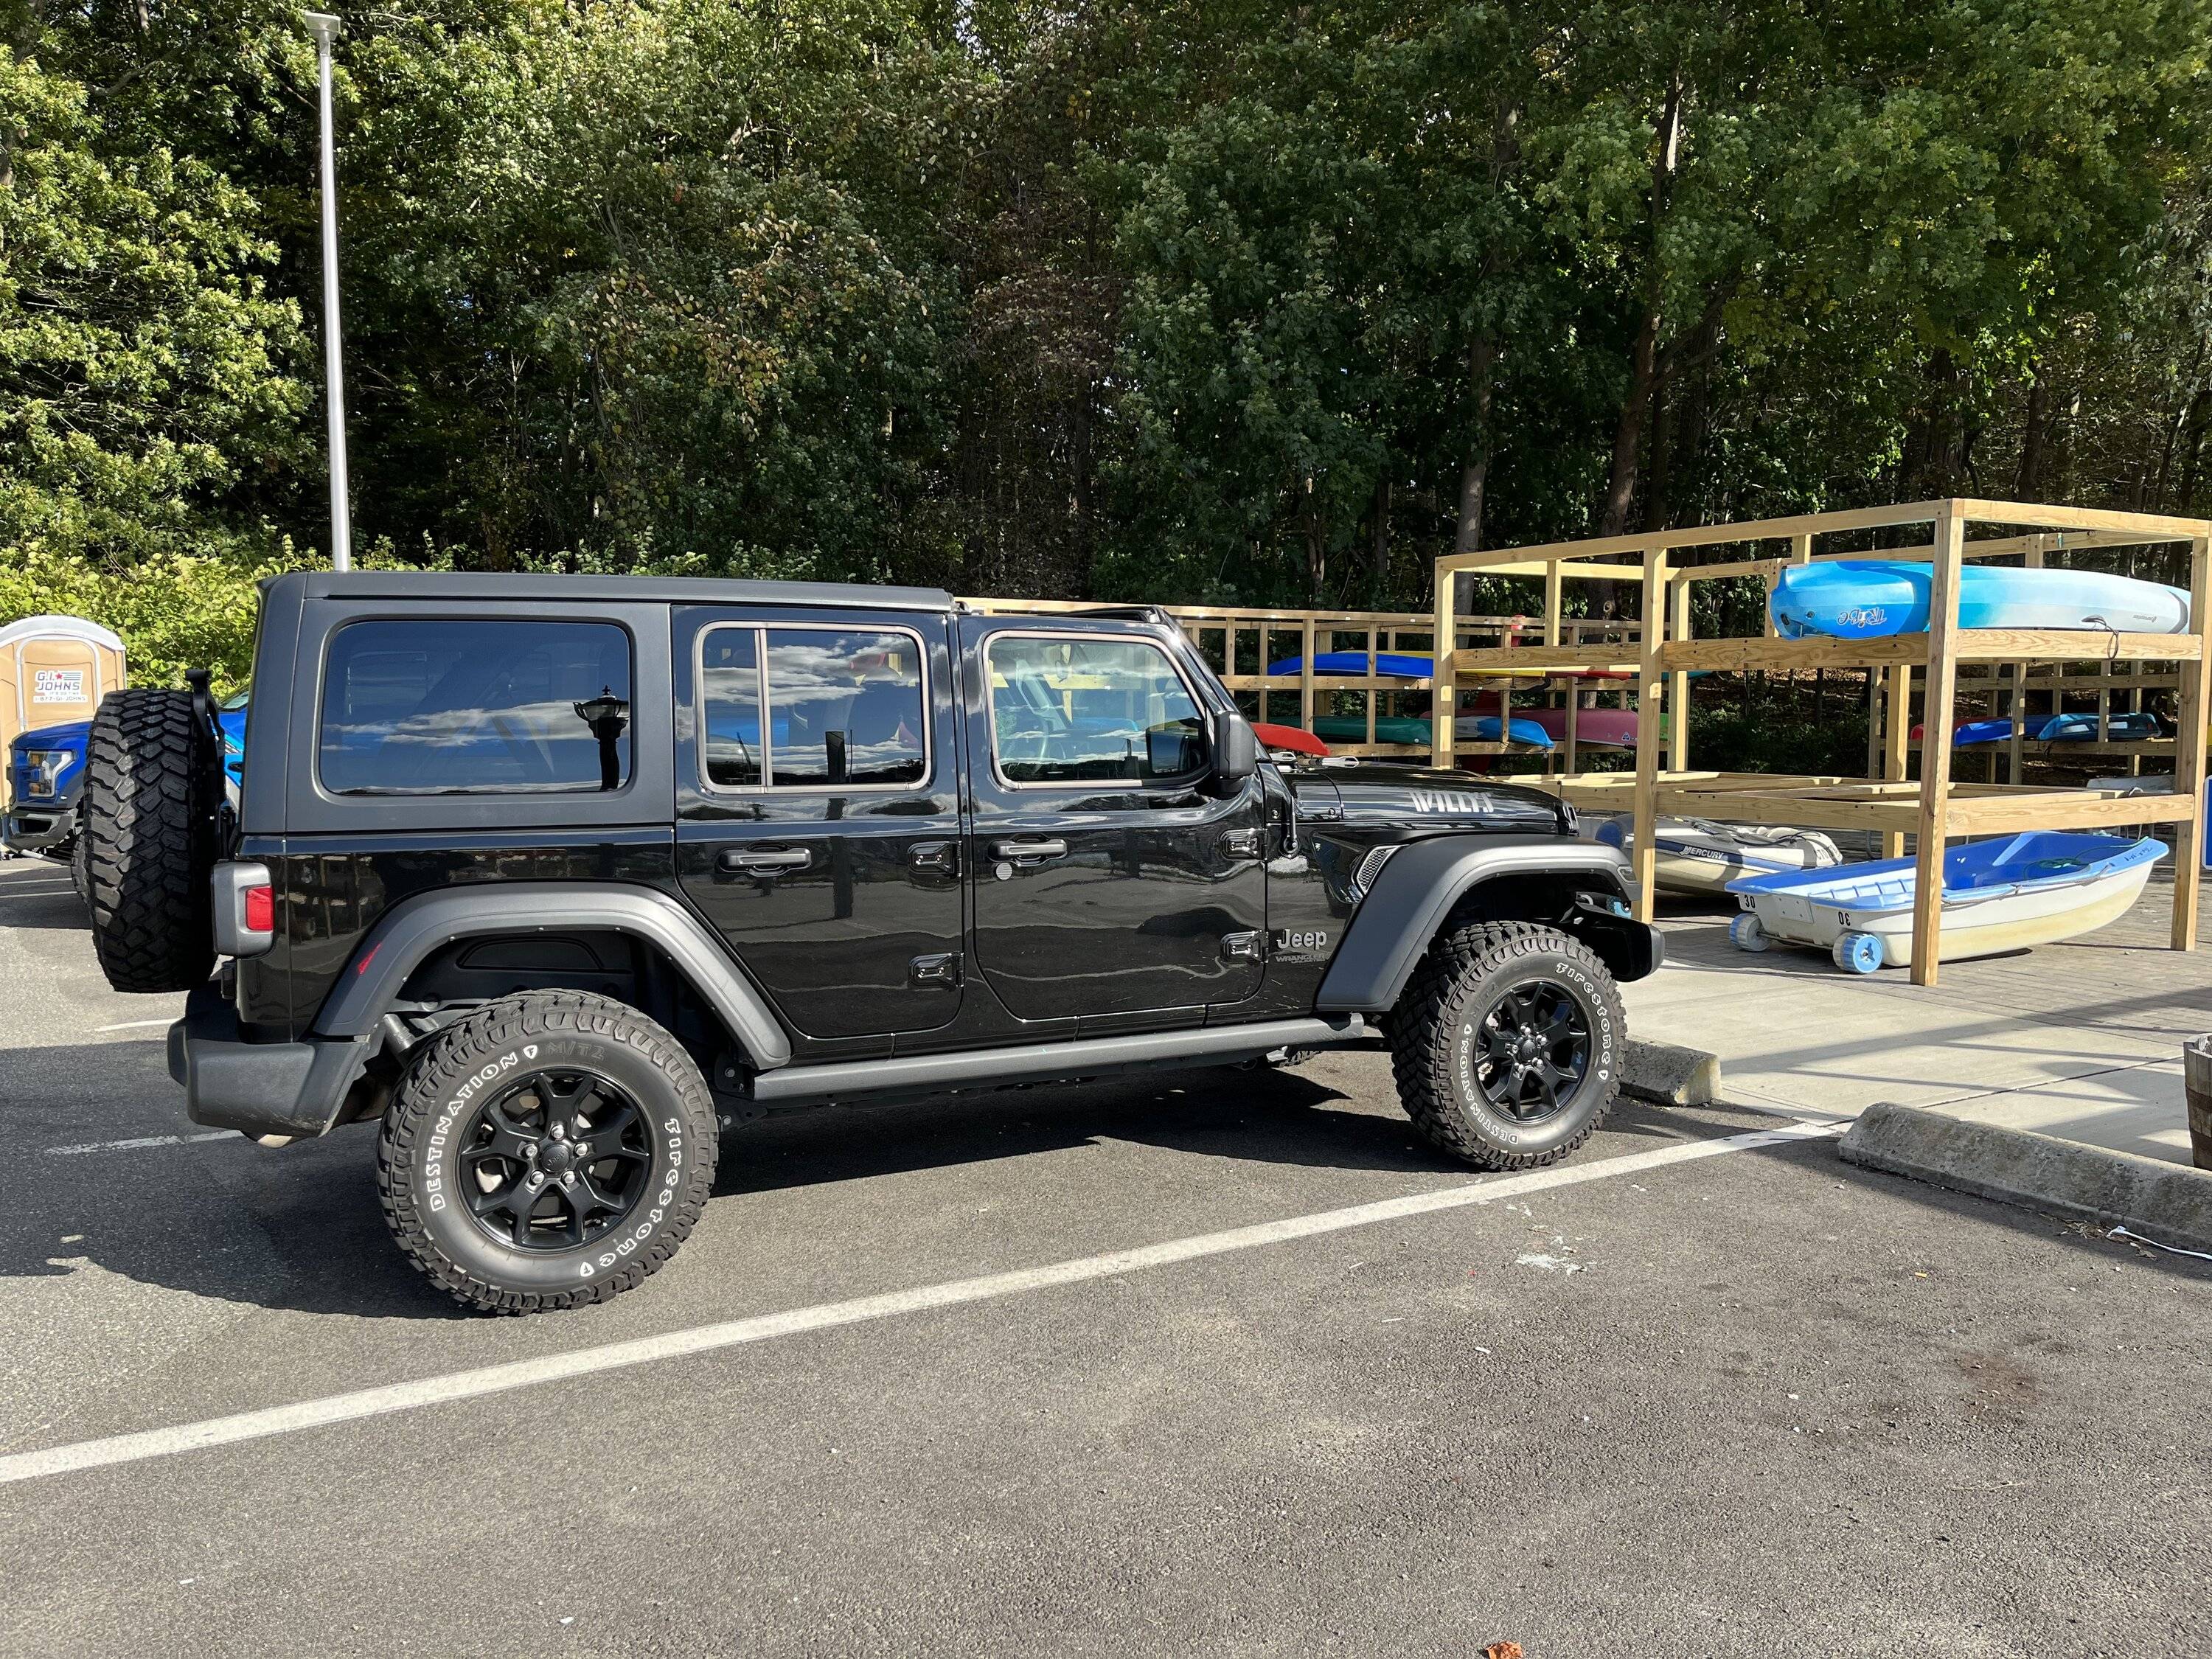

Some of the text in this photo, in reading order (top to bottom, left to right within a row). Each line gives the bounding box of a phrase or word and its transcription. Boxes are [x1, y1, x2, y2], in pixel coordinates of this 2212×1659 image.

[37, 681, 80, 691] JOHNS
[1408, 789, 1495, 813] WILLYS
[1680, 845, 1725, 860] MERCURY
[1744, 894, 1756, 909] 30
[1276, 928, 1327, 950] Jeep
[1556, 962, 1612, 1065] Firestone
[1459, 1040, 1519, 1145] DESTINATION
[425, 1051, 518, 1212] DESTINATION
[599, 1118, 682, 1267] Firestone
